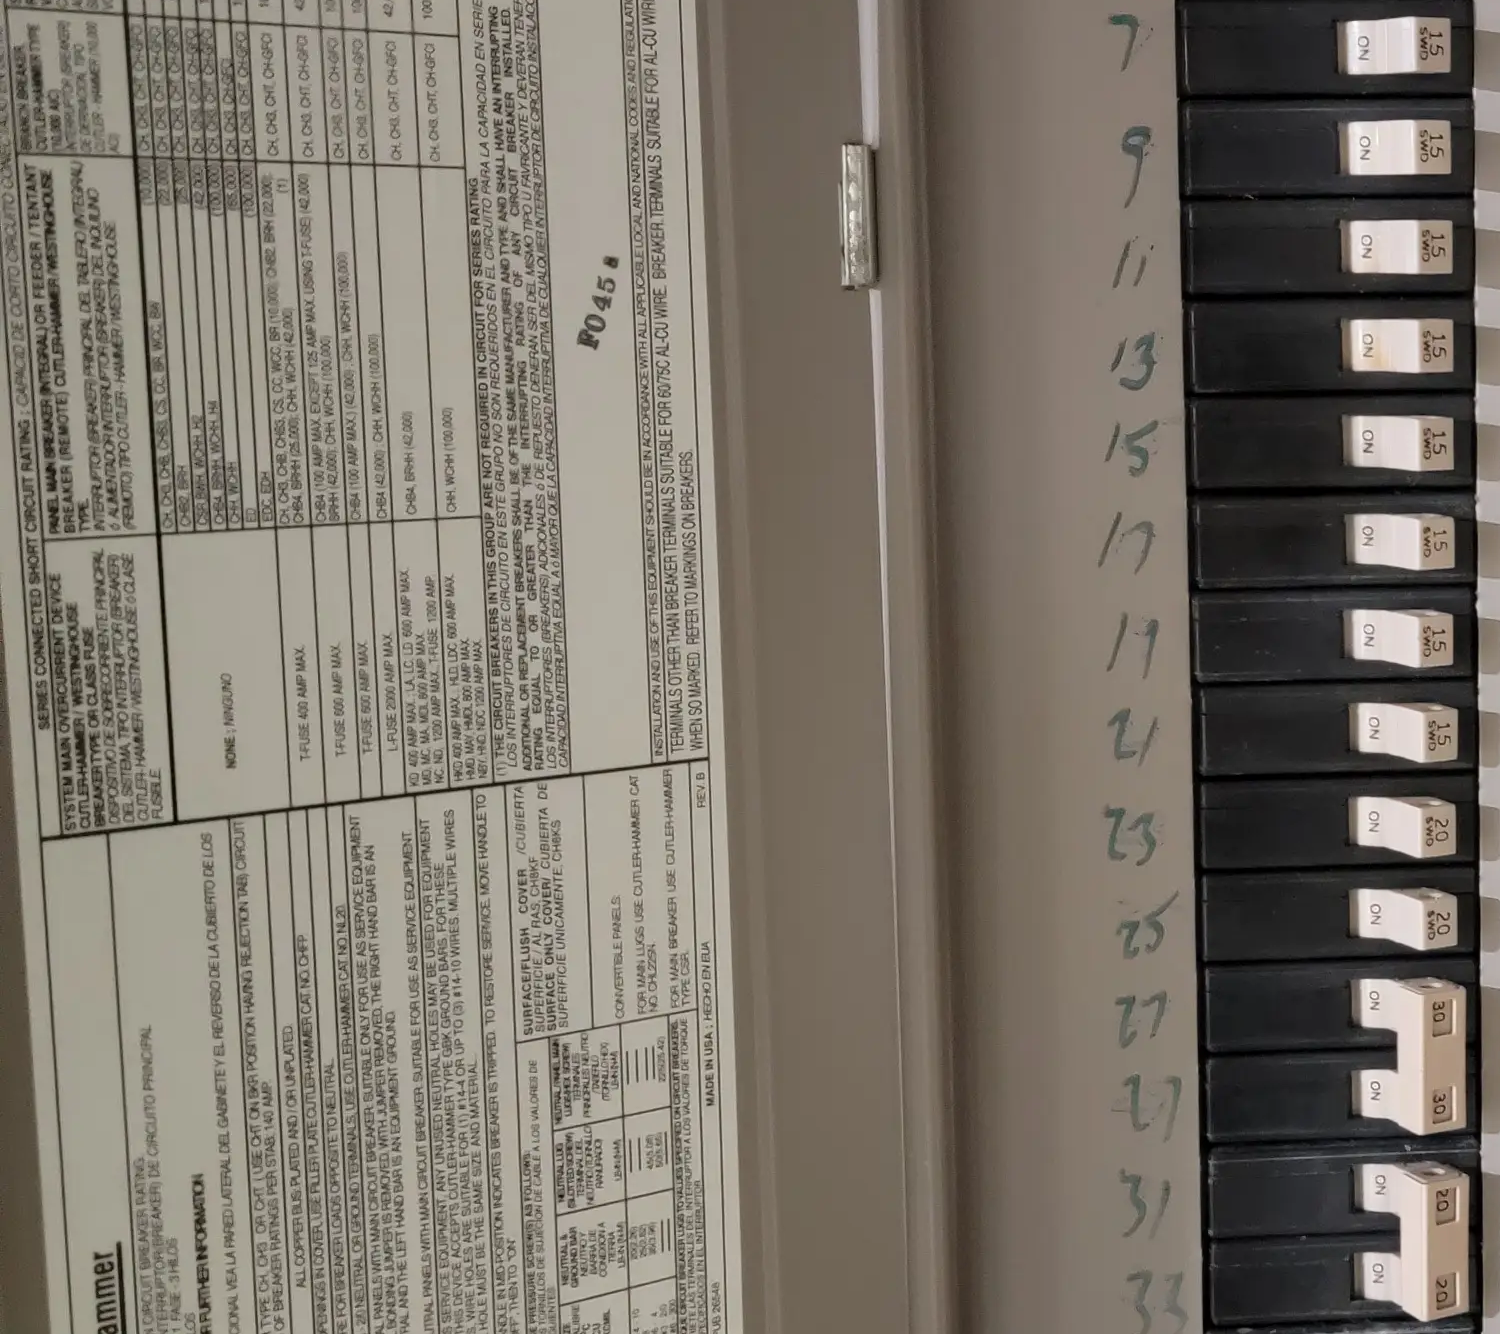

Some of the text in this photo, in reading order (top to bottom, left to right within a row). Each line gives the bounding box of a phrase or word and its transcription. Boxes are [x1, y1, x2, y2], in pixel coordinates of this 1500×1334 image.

[1108, 13, 1140, 71] 7
[1122, 126, 1152, 208] 9
[1111, 331, 1157, 390] 13
[1362, 334, 1374, 359] ON
[1422, 331, 1432, 363] SWD
[1432, 334, 1447, 359] 15
[1105, 419, 1158, 477] 15
[682, 513, 695, 527] ON
[682, 531, 697, 588] MARKINGS
[1098, 511, 1155, 574] 17
[684, 592, 698, 606] TO
[684, 608, 699, 644] REFER
[688, 700, 701, 715] SO
[688, 718, 703, 751] WHEN
[1107, 707, 1160, 766] 21
[1105, 807, 1156, 866] 23
[1369, 811, 1380, 833] ON
[1425, 817, 1434, 846] SWD
[1434, 818, 1449, 843] 20
[518, 868, 528, 914] COVER
[1369, 991, 1380, 1011] ON
[1431, 1000, 1445, 1023] 30
[705, 1032, 715, 1106] MADE IN USA
[1120, 1169, 1170, 1240] 31
